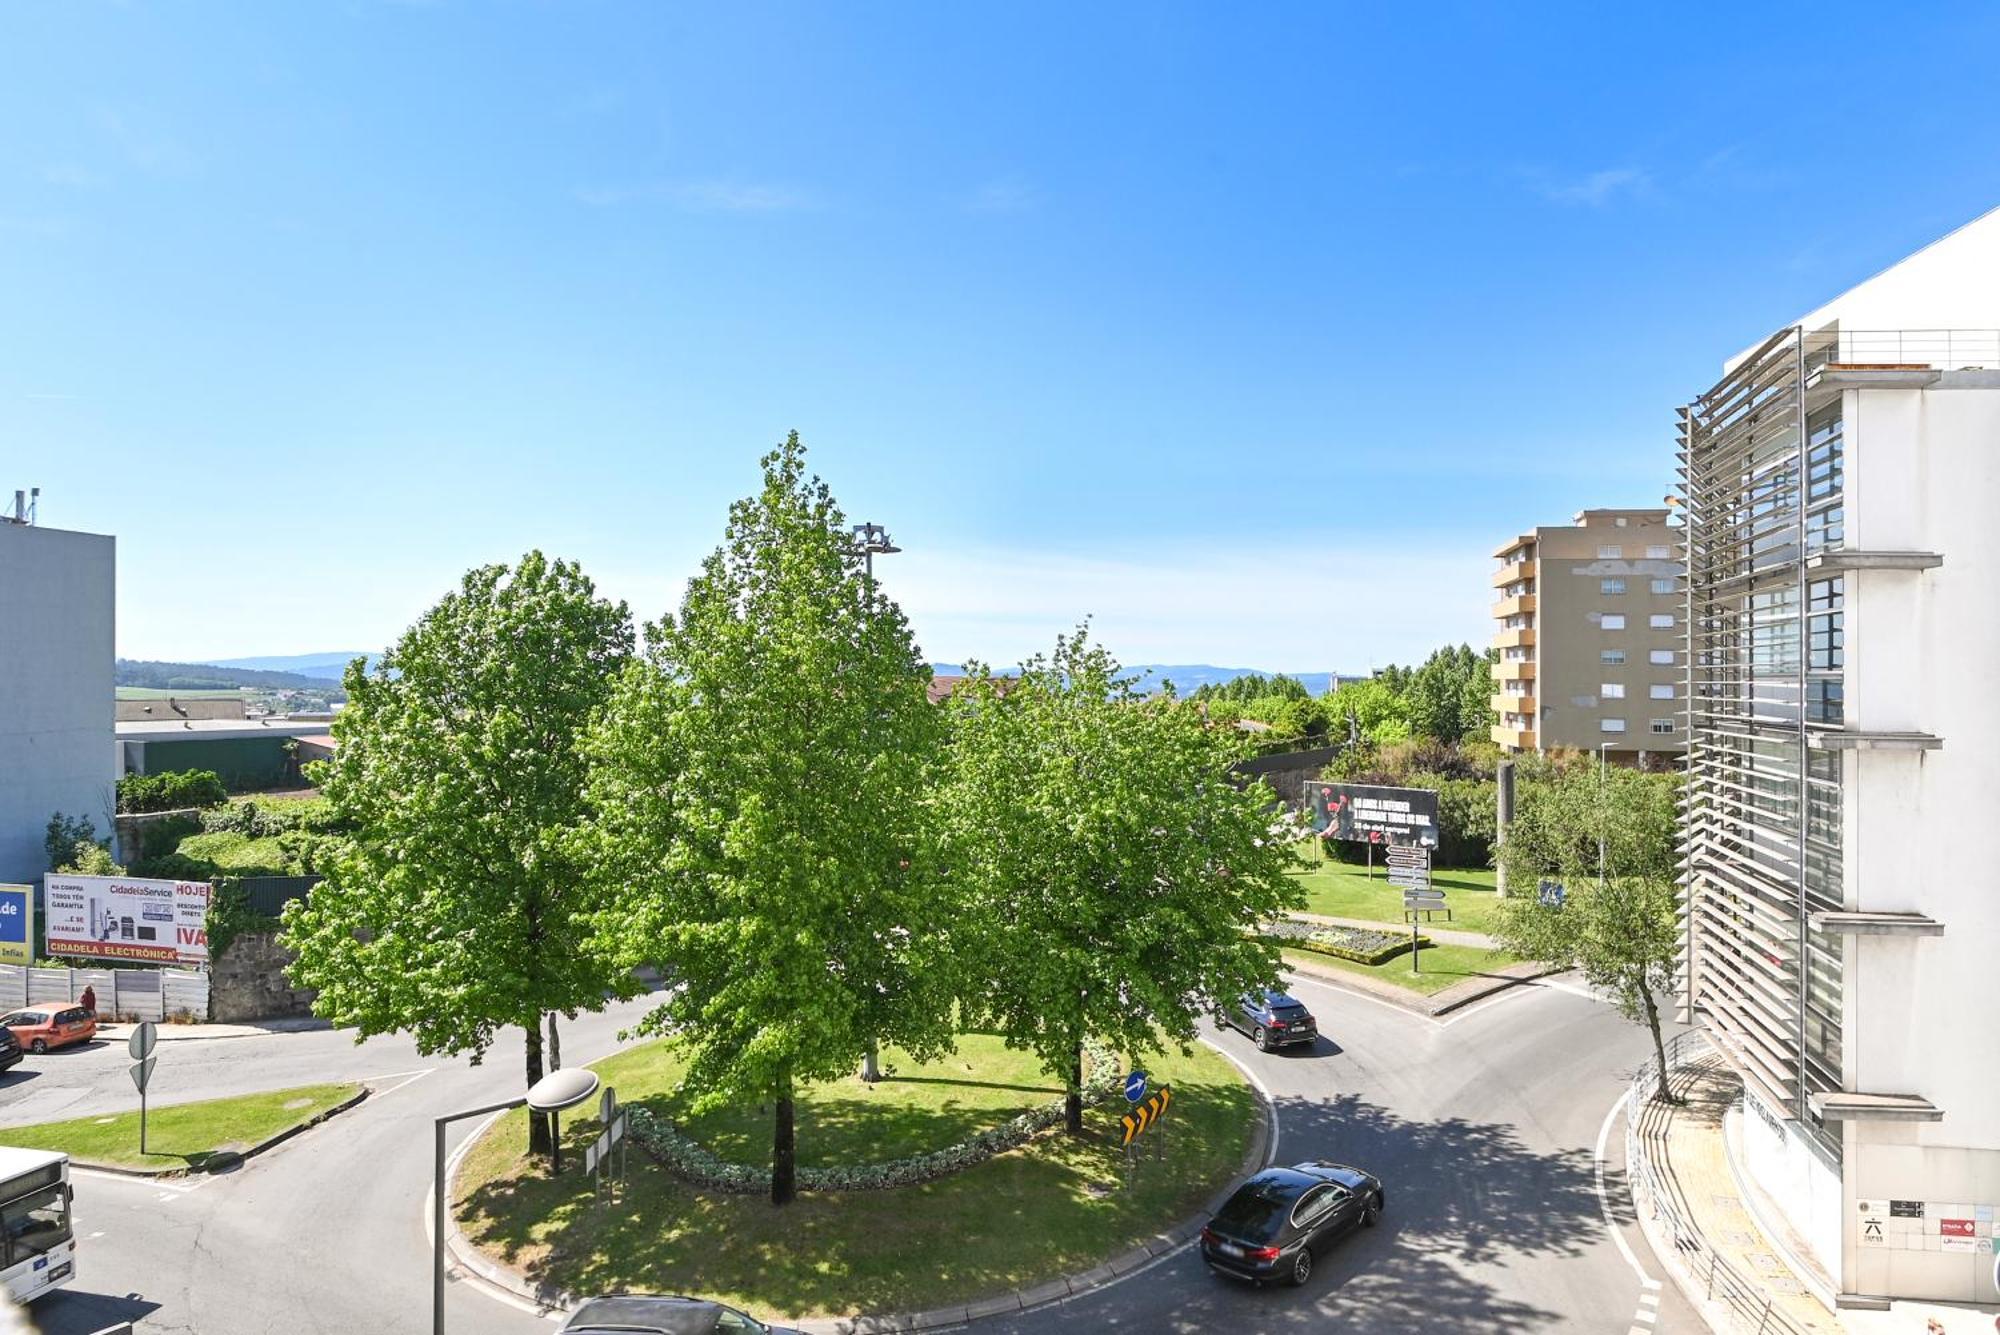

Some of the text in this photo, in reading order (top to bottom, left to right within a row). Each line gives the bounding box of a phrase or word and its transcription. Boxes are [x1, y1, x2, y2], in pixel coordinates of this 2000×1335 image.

[110, 884, 173, 898] CidadelaService
[176, 885, 205, 897] HOJE
[51, 902, 84, 910] GARANTIA
[176, 903, 206, 911] DESCONTO
[176, 927, 207, 947] IVA
[50, 943, 100, 955] CIDADELA
[104, 946, 174, 959] ELECTRÓNICA
